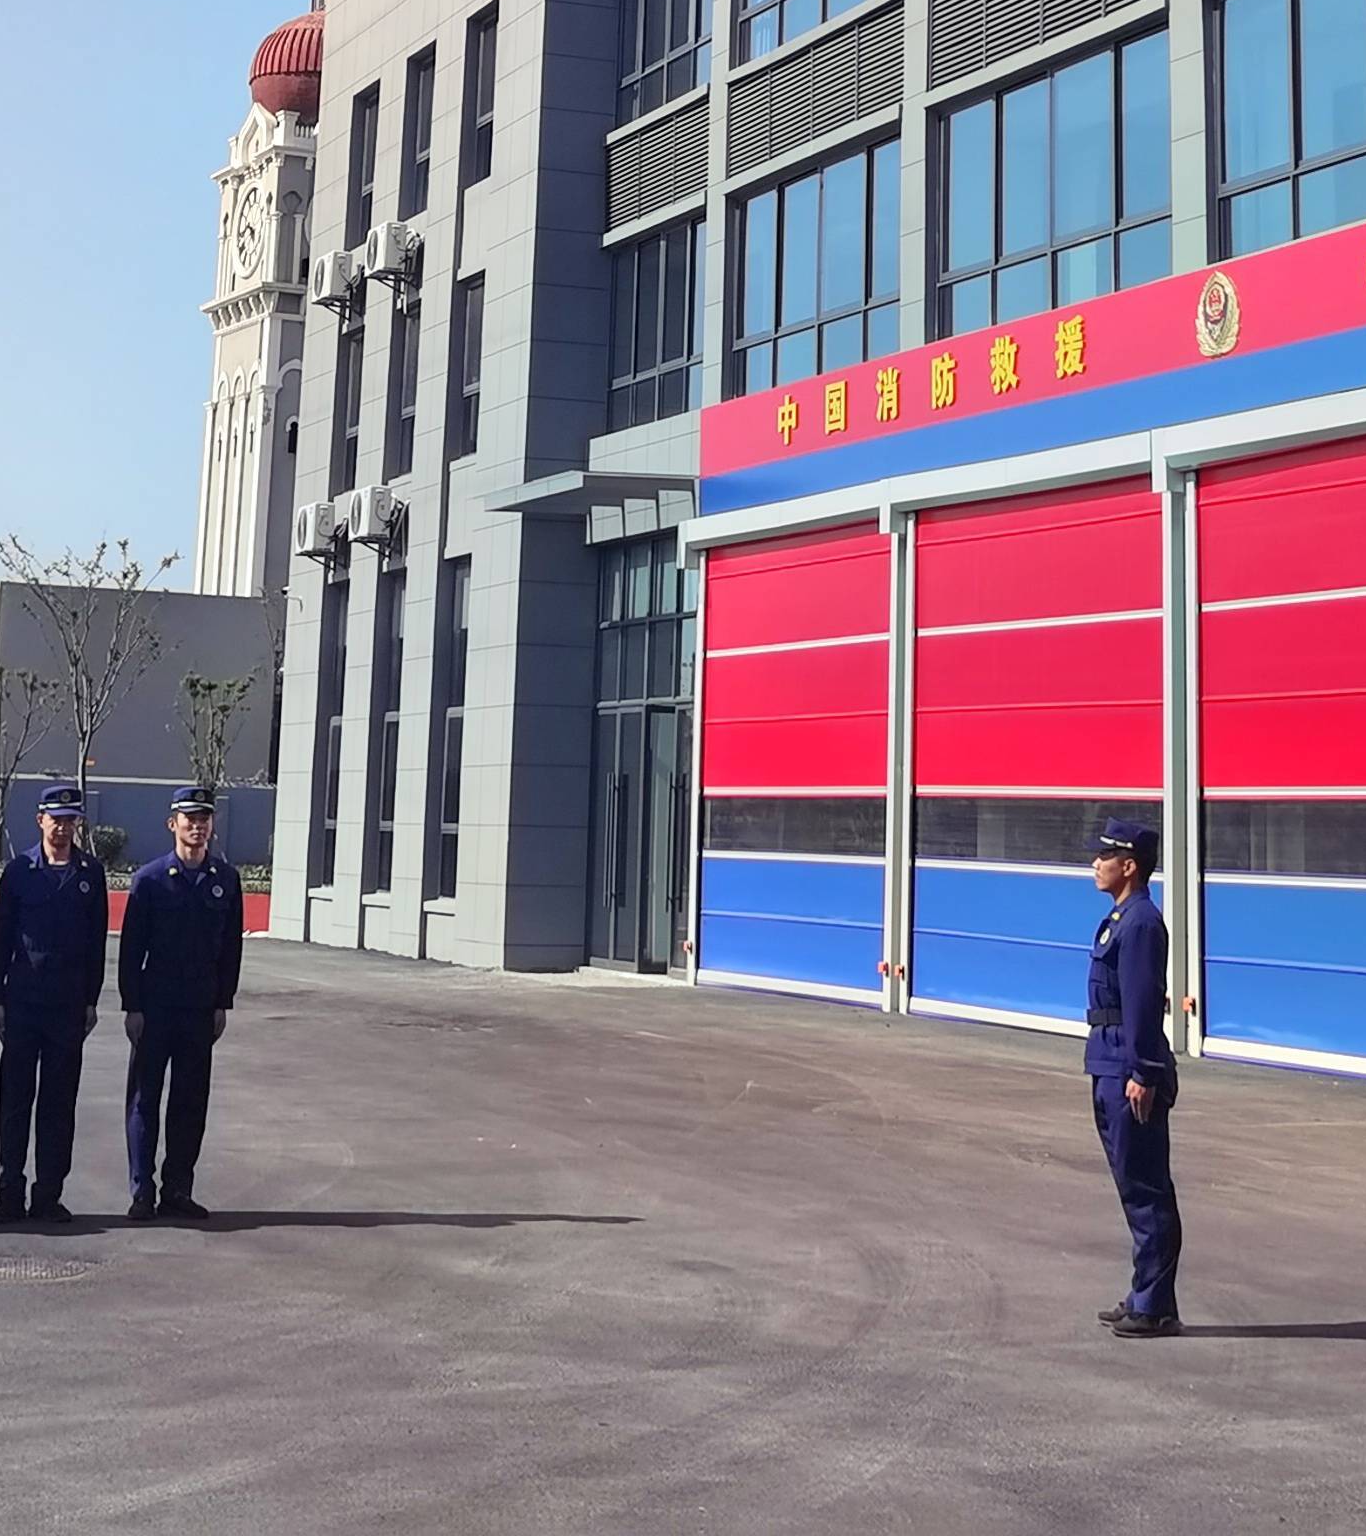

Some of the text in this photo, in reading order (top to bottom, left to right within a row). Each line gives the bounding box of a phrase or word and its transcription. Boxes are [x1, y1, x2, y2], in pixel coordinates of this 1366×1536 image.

[776, 315, 1086, 446] 中国消防救援
